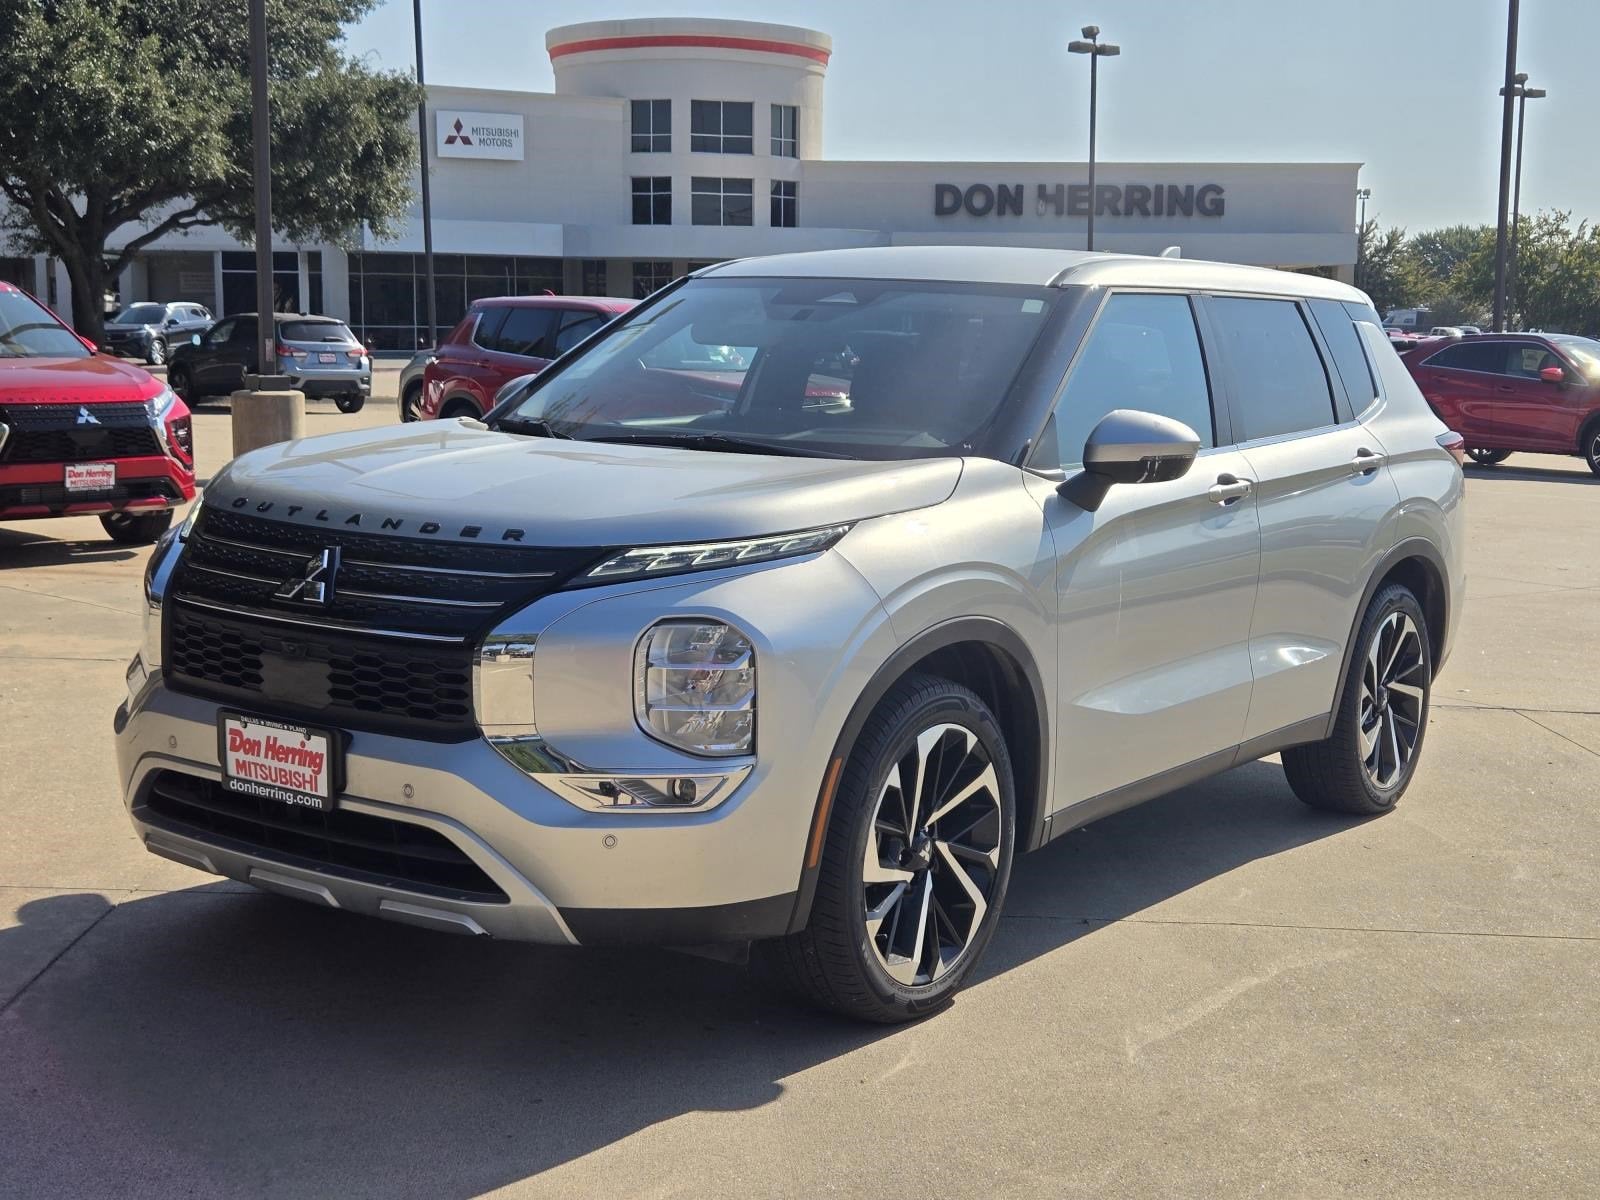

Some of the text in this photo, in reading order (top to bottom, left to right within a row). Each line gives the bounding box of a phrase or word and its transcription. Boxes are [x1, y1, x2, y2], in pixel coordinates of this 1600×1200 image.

[471, 127, 519, 138] MITSUBISHI
[479, 137, 513, 148] MOTORS
[934, 184, 1225, 217] DON HERRING
[232, 497, 526, 542] OUTLANDER
[241, 715, 307, 734] DALLAS IRVING PLANO
[229, 728, 324, 775] Don Herring
[235, 758, 318, 793] MITSUBISHI
[229, 778, 322, 808] donherring.com
